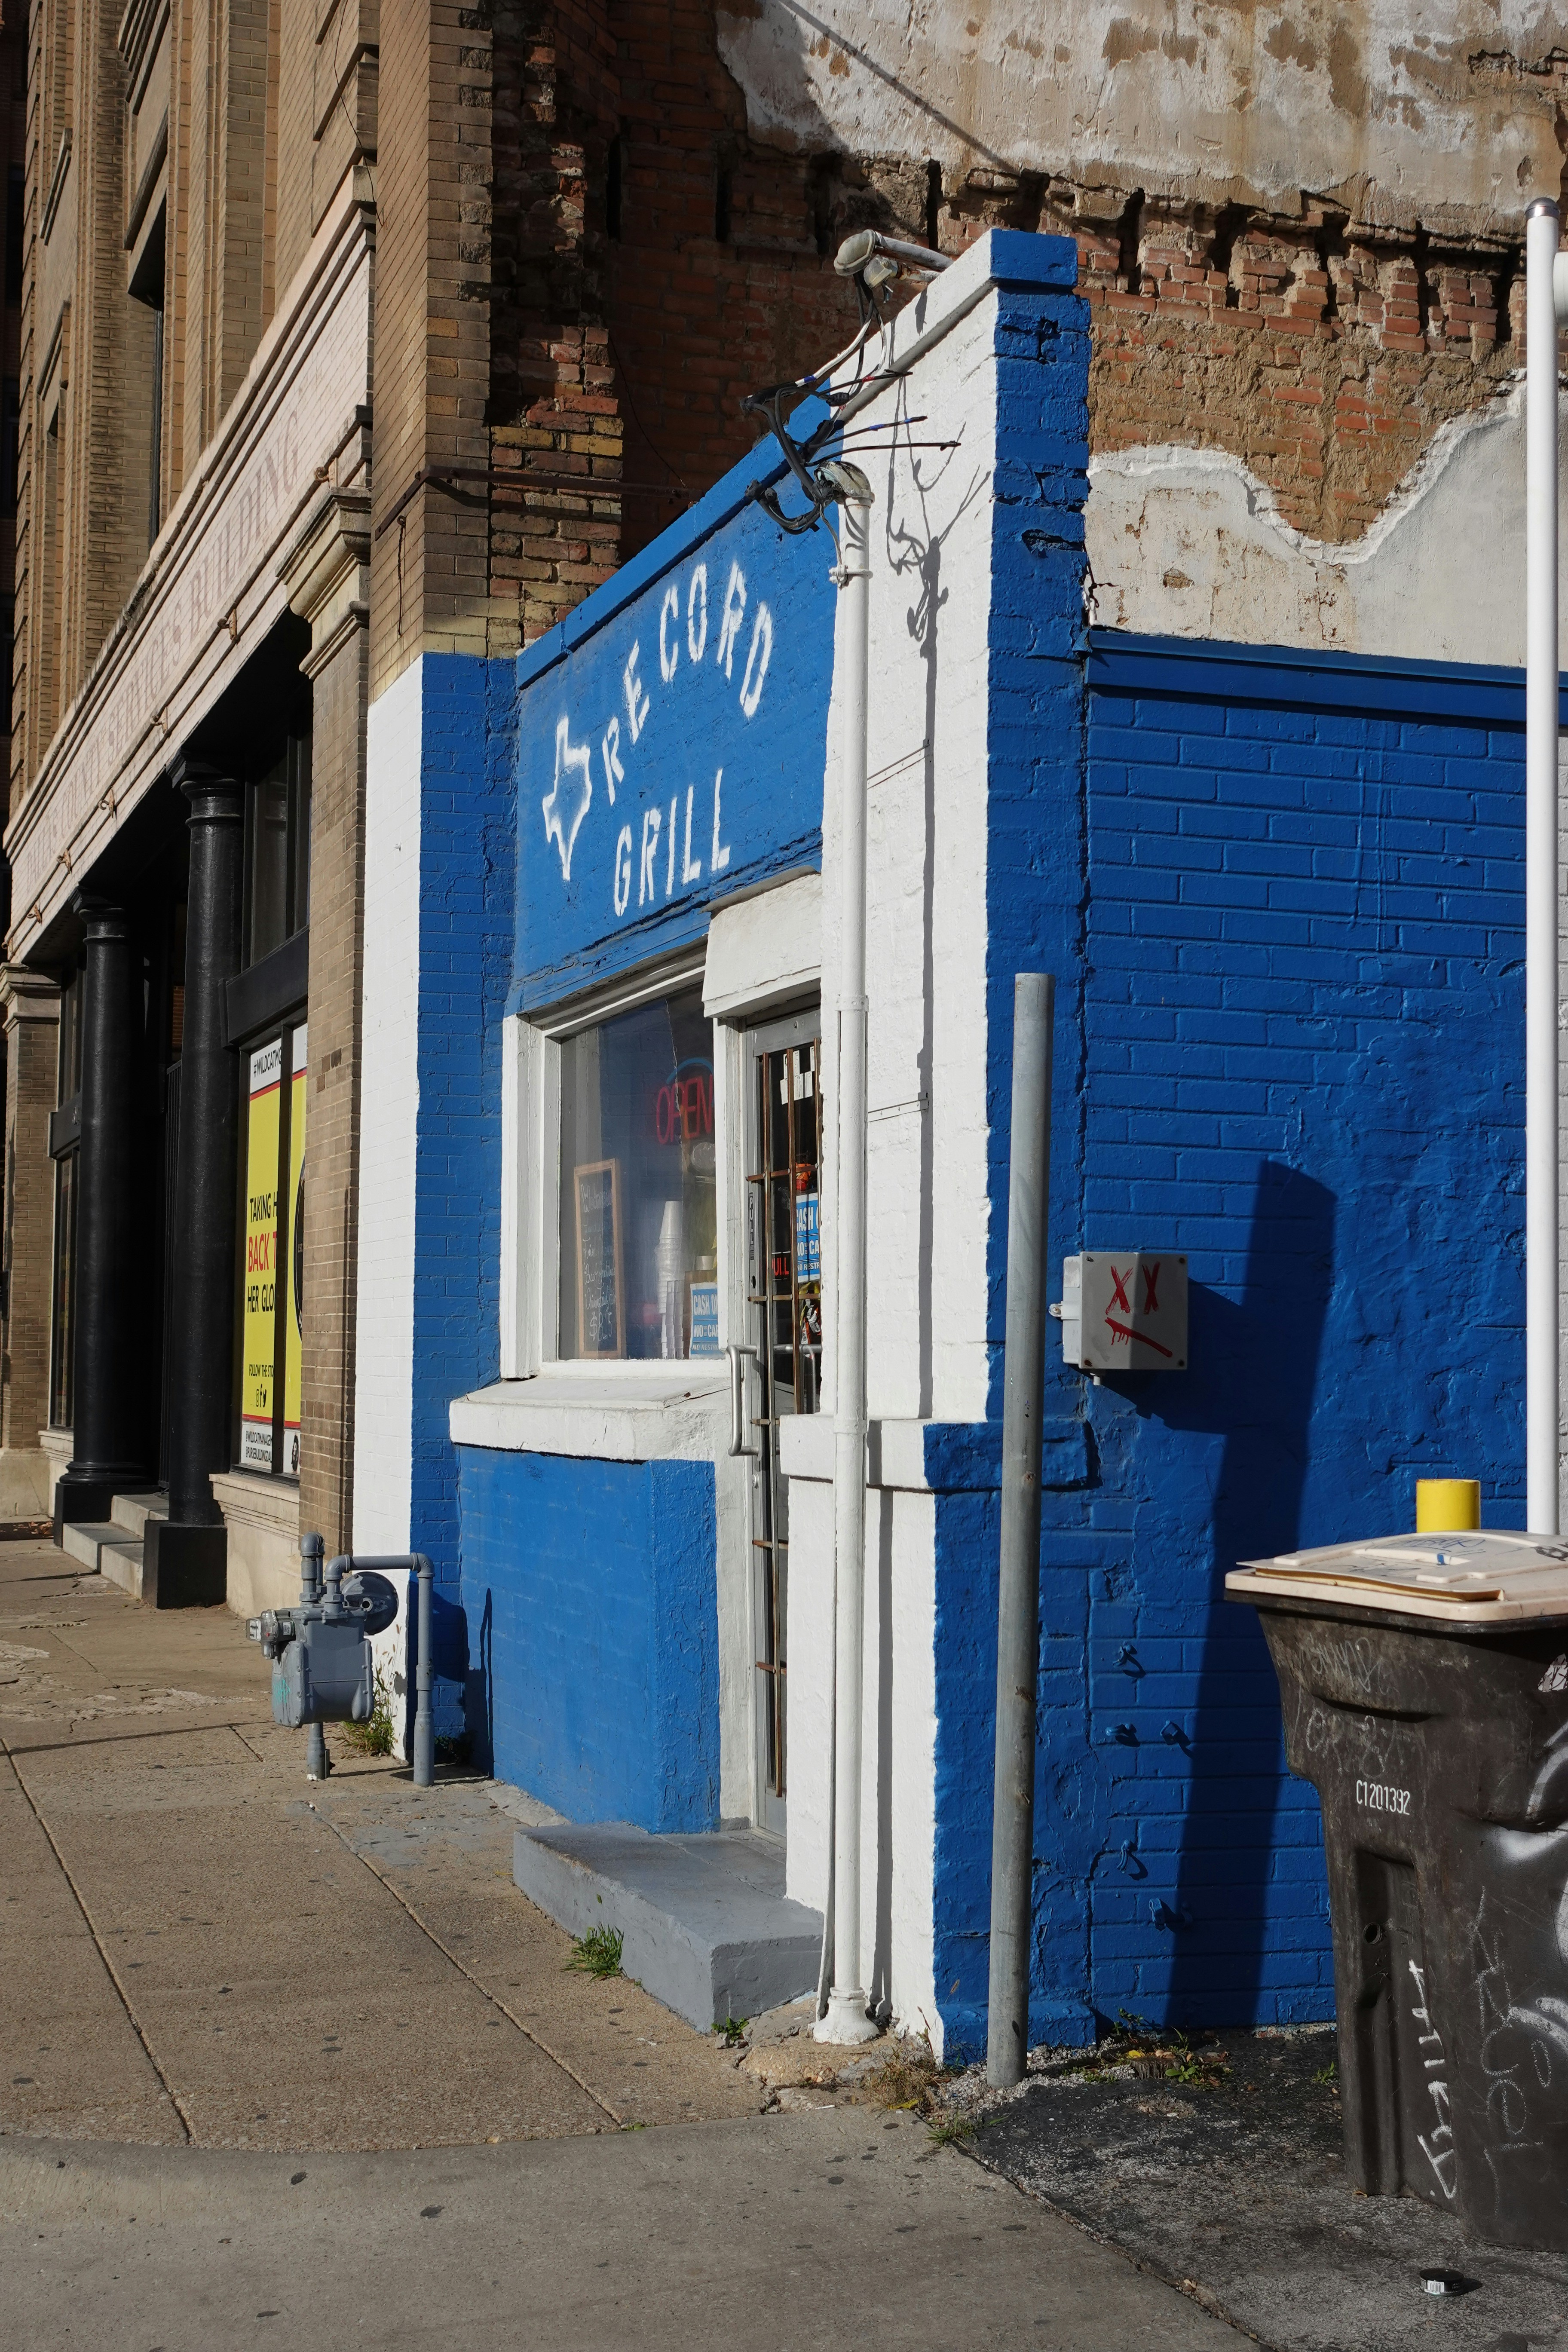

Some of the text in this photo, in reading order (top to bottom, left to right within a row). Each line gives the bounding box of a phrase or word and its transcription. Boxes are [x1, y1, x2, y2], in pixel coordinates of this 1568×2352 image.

[107, 600, 181, 768] SERVICES
[190, 410, 299, 644] BUILDING
[602, 559, 773, 806] RECORD
[614, 768, 732, 917] GRILL
[656, 1074, 714, 1144] OPEN
[250, 1193, 271, 1223] TAKING
[248, 1232, 270, 1273] BACK
[247, 1285, 259, 1313] HER
[693, 1294, 710, 1316] CASH
[694, 1324, 703, 1338] NO
[249, 1364, 261, 1377] FOLLOW
[1357, 1779, 1410, 1815] C1201392
